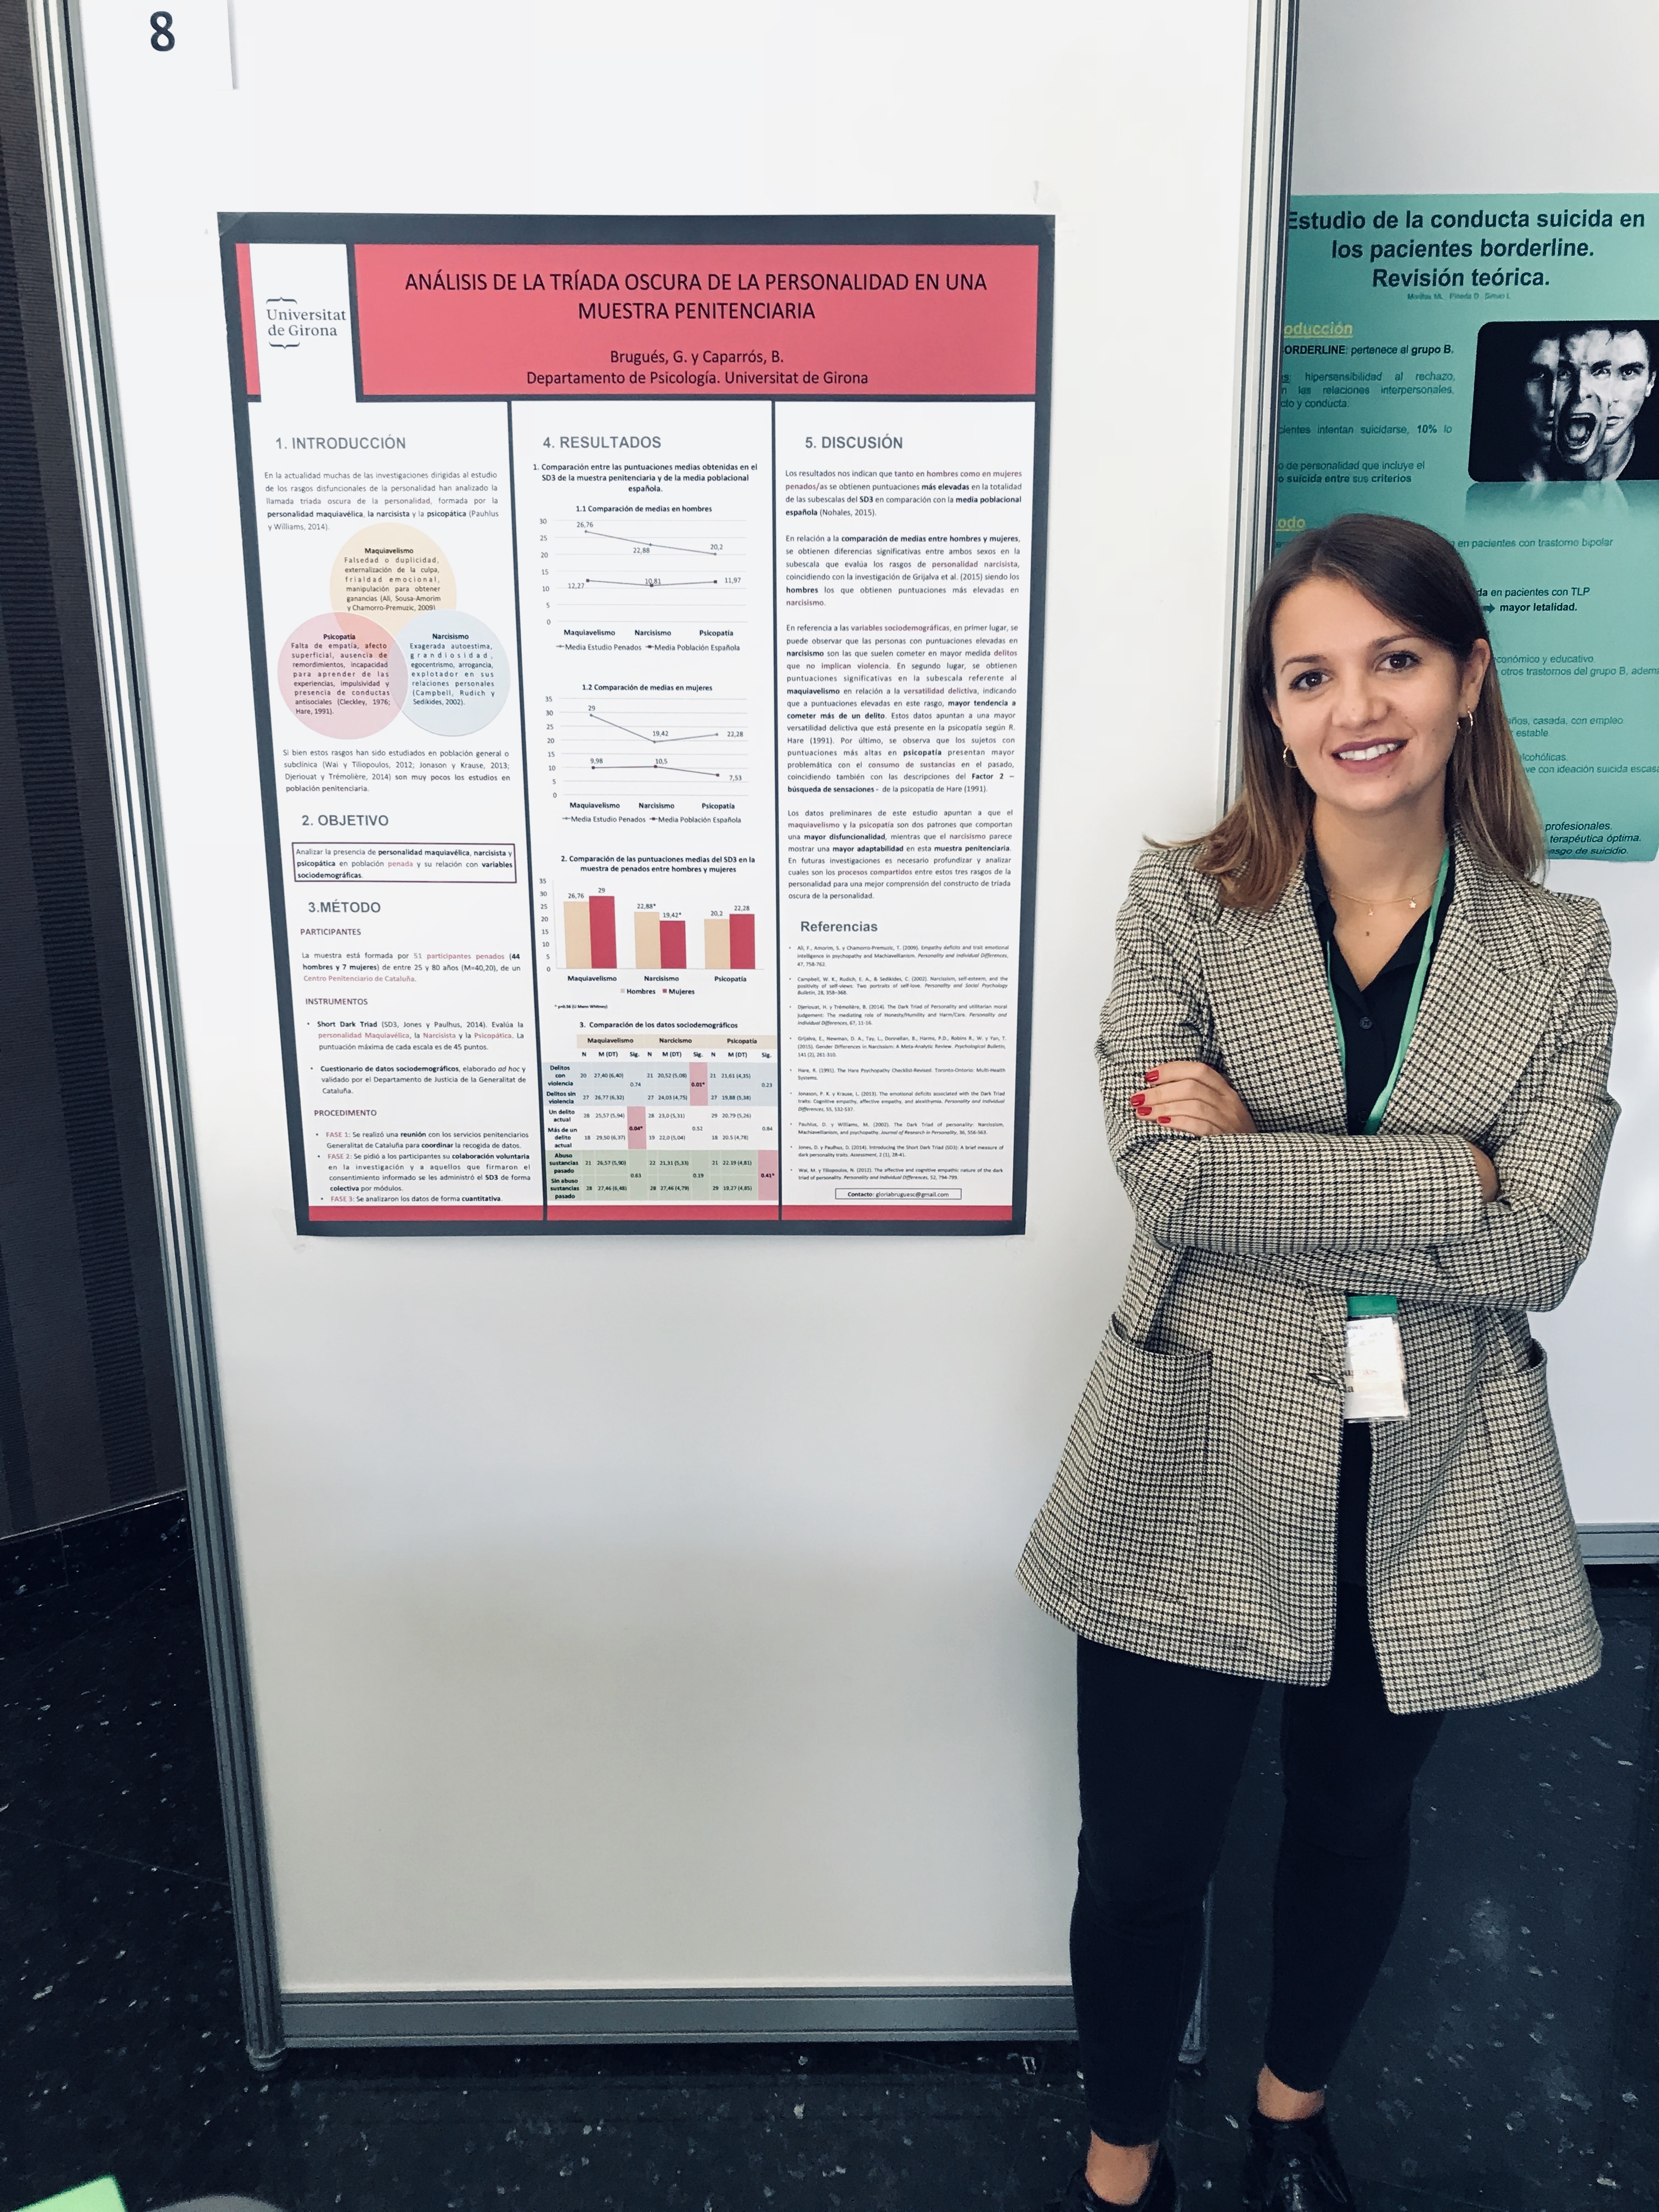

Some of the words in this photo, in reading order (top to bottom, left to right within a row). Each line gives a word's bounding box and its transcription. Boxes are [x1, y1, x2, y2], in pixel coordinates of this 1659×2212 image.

[150, 10, 176, 52] 8
[1289, 211, 1365, 230] Estudio
[1373, 211, 1398, 229] de
[1406, 210, 1423, 228] la
[1431, 210, 1529, 228] conducta
[1537, 209, 1612, 227] suicida
[1620, 213, 1644, 227] en
[1333, 240, 1363, 258] los
[1370, 239, 1472, 263] pacientes
[1481, 238, 1593, 257] borderline.
[405, 269, 487, 290] ANÁLISIS
[494, 274, 517, 290] DE
[524, 274, 545, 290] LA
[550, 269, 619, 290] TRÍADA
[625, 274, 702, 290] OSCURA
[708, 274, 731, 290] DE
[738, 274, 760, 290] LA
[766, 274, 909, 290] PERSONALIDAD
[916, 274, 939, 291] EN
[946, 274, 987, 290] UNA
[1373, 268, 1464, 287] Revisión
[1471, 267, 1549, 286] teórica.
[267, 309, 346, 320] Universitat
[579, 303, 669, 319] MUESTRA
[675, 302, 815, 319] PENITENCIARIA
[268, 325, 284, 336] de
[289, 325, 337, 336] Girona
[1283, 345, 1348, 355] ORDERLINE:
[1351, 346, 1398, 357] pertenece
[1400, 345, 1409, 354] al
[1410, 346, 1441, 357] grupo
[1443, 344, 1454, 354] B.
[611, 349, 668, 366] Brugués,
[673, 351, 687, 363] G.
[703, 349, 766, 365] Caparrós,
[772, 351, 783, 363] B.
[527, 371, 625, 387] Departamento
[629, 371, 646, 383] de
[651, 370, 720, 386] Psicología.
[725, 371, 798, 383] Universitat
[803, 371, 819, 383] de
[823, 371, 868, 384] Girona
[1305, 372, 1382, 383] hipersensibilidad
[1395, 371, 1403, 381] al
[1415, 371, 1455, 382] rechazo,
[276, 438, 287, 449] 1.
[292, 435, 405, 449] INTRODUCCIÓN
[543, 437, 554, 448] 4.
[560, 436, 661, 448] RESULTADOS
[805, 437, 816, 448] 5.
[822, 433, 902, 449] DISCUSIÓN
[541, 463, 589, 472] Comparación
[624, 463, 673, 472] puntuaciones
[1286, 461, 1299, 470] de
[1301, 460, 1359, 472] personalidad
[1362, 462, 1380, 472] que
[1383, 461, 1414, 472] incluye
[1416, 460, 1425, 470] el
[375, 472, 429, 481] investigaciones
[431, 471, 460, 480] dirigidas
[799, 469, 836, 477] resultados
[993, 470, 1022, 479] mujeres
[1286, 473, 1323, 483] suicida
[1324, 474, 1350, 483] entre
[1371, 473, 1412, 483] criterios
[364, 547, 414, 555] Maquiavelismo
[1499, 605, 1531, 614] mayor
[1533, 602, 1578, 612] letalidad.
[301, 815, 314, 826] 2.
[318, 815, 388, 826] OBJETIVO
[1544, 821, 1612, 832] profesionales.
[1550, 834, 1604, 845] terapéutica
[1606, 833, 1641, 844] óptima.
[308, 899, 381, 913] 3.MÉTODO
[800, 921, 878, 932] Referencias
[676, 1022, 738, 1030] sociodemográficos
